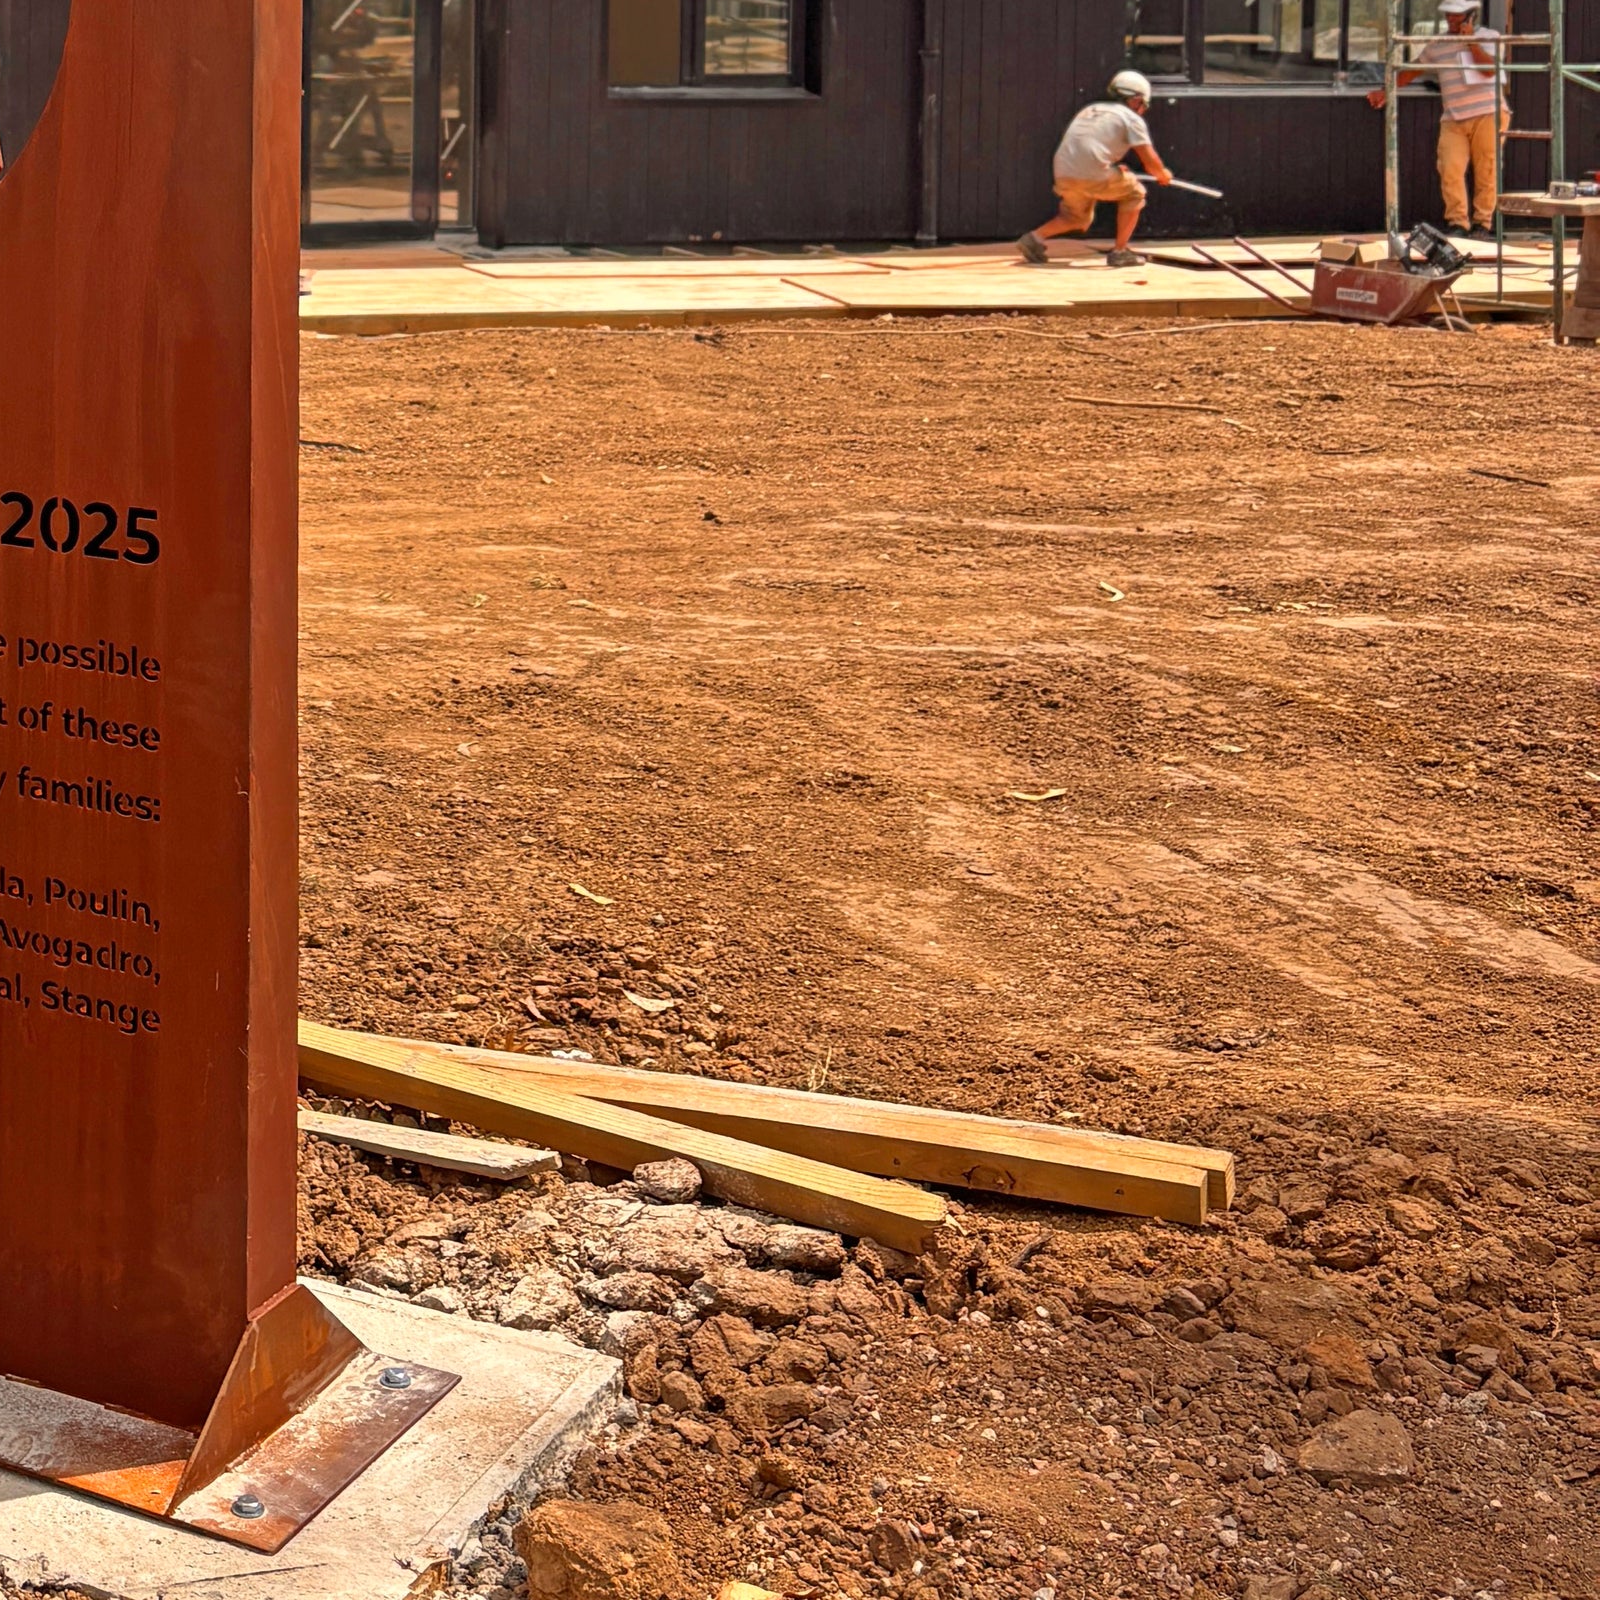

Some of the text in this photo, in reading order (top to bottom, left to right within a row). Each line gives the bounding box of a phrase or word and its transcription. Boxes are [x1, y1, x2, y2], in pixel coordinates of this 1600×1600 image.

[0, 491, 160, 565] 2025
[17, 637, 161, 681] possible
[17, 701, 53, 732] of
[61, 707, 161, 751] these
[16, 765, 161, 822] families:
[45, 876, 160, 933] Poulin,
[41, 980, 161, 1034] Stange
